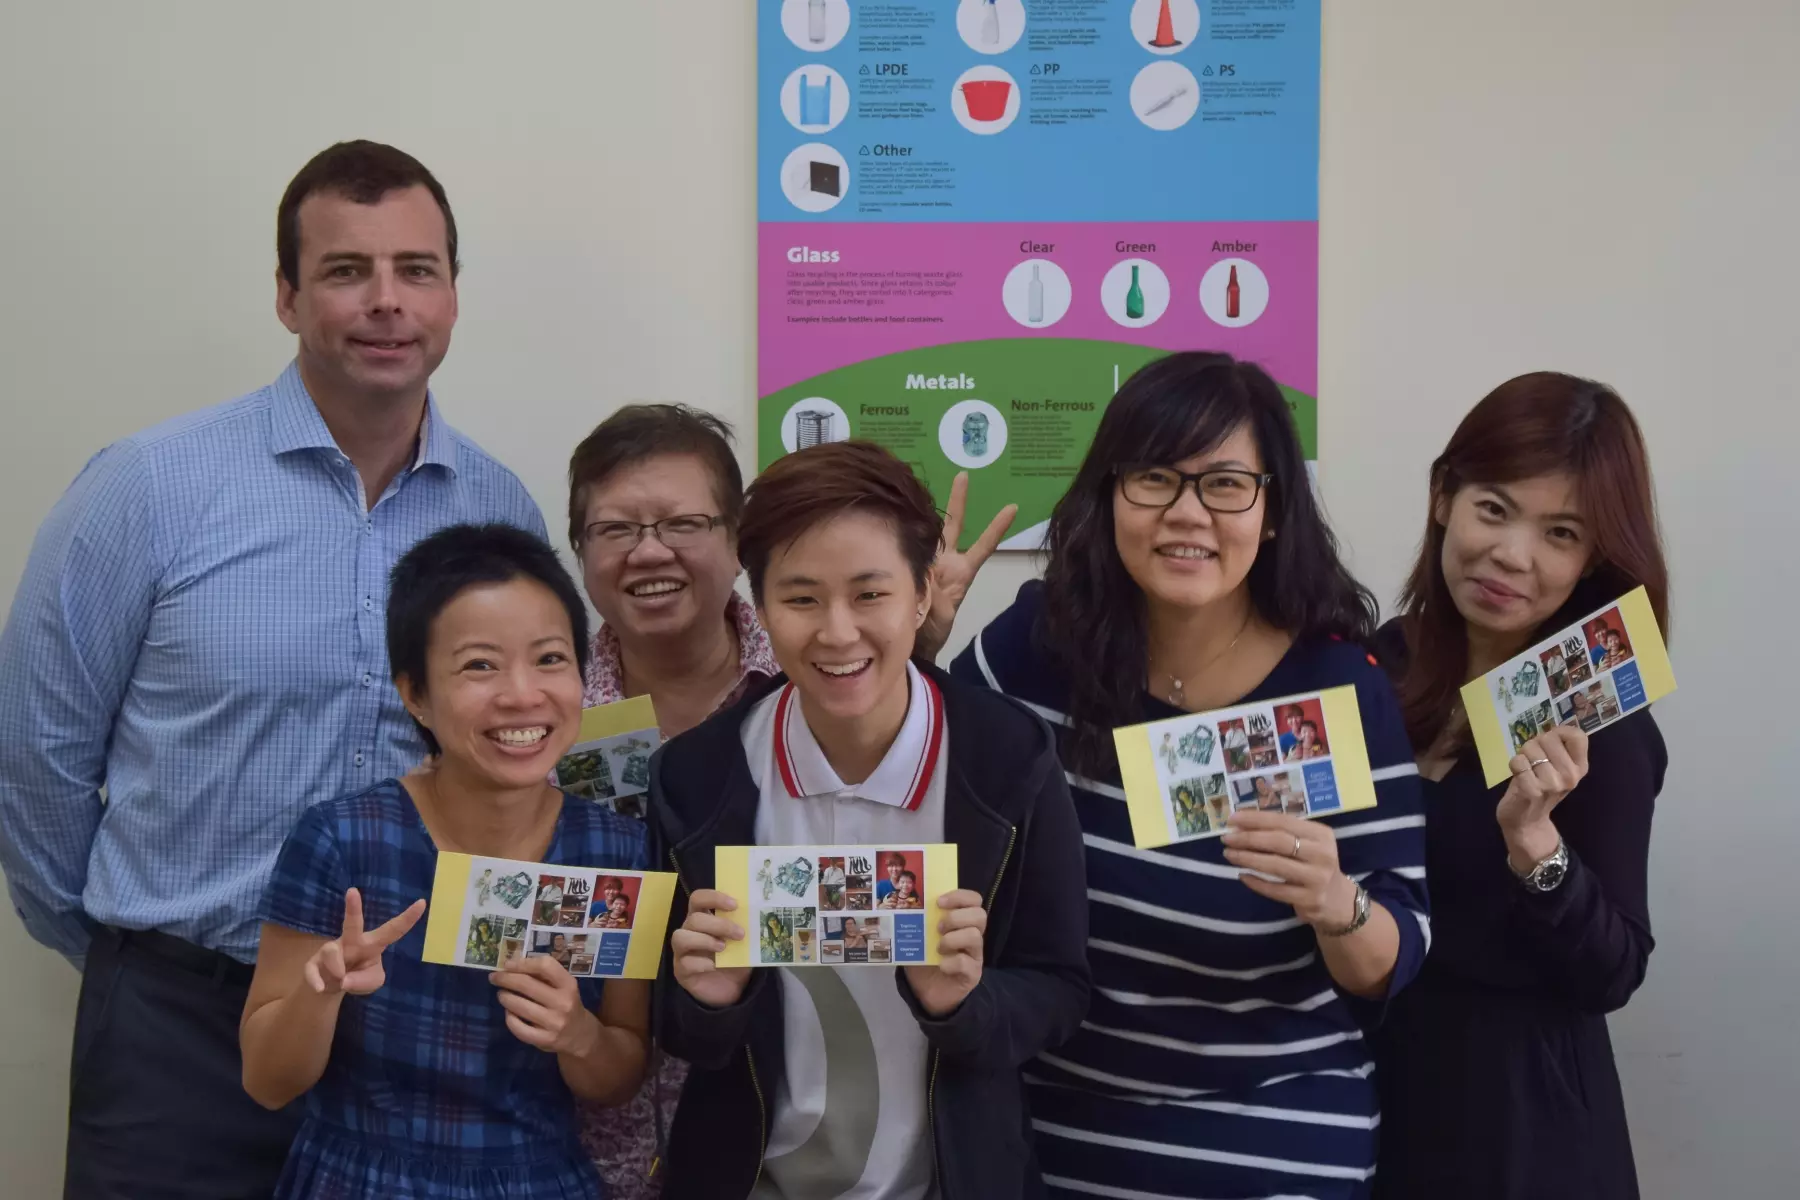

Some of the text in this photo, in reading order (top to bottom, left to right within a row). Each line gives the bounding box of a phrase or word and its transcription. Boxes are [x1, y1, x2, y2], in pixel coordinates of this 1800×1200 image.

[876, 64, 908, 76] LPDE
[1044, 64, 1060, 75] PP
[1220, 64, 1236, 76] PS
[873, 144, 913, 156] Other
[1020, 240, 1055, 253] Clear
[1115, 240, 1156, 253] Green
[1211, 240, 1258, 253] Amber
[787, 246, 841, 263] Glass
[787, 316, 820, 324] Examples
[905, 373, 976, 390] Metals
[860, 403, 910, 416] Ferrous
[1011, 399, 1096, 412] Non-Ferrous
